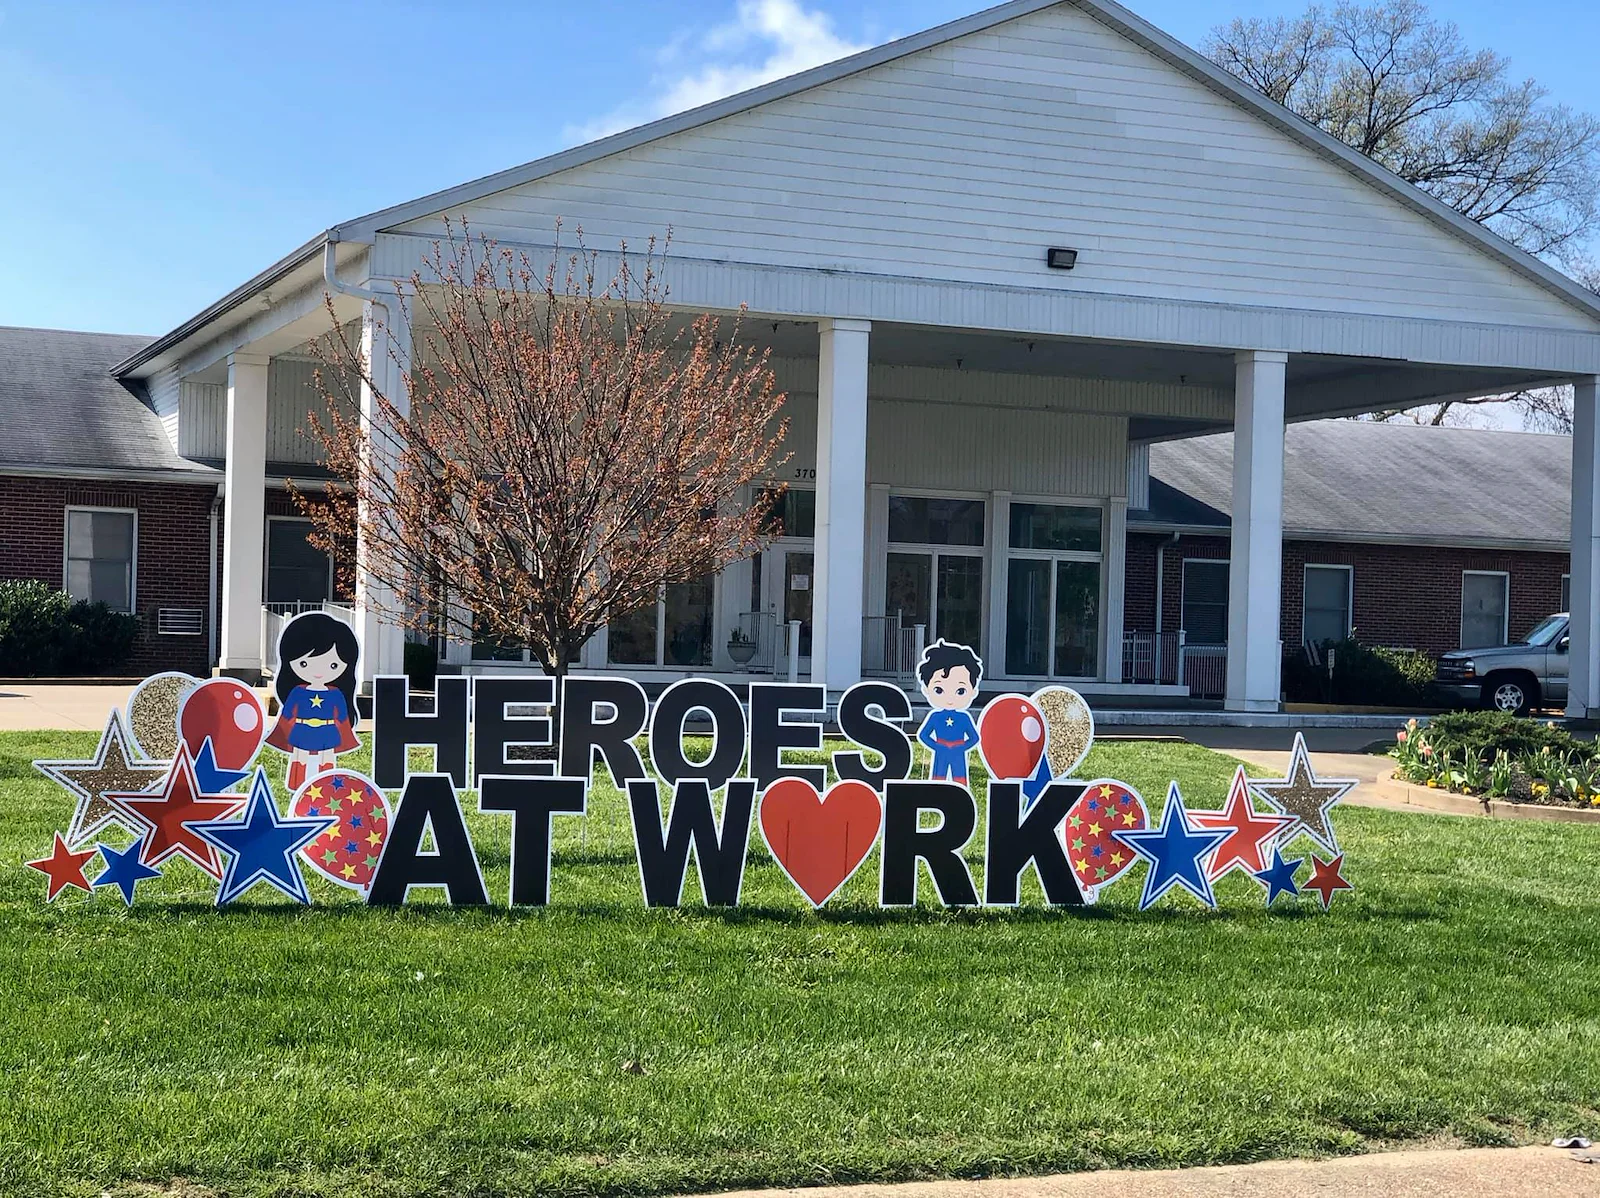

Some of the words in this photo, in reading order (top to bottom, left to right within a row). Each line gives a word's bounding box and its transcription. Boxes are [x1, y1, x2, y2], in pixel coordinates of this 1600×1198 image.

[373, 675, 913, 791] HEROES
[366, 773, 588, 908] AT
[625, 775, 1087, 908] WRK
